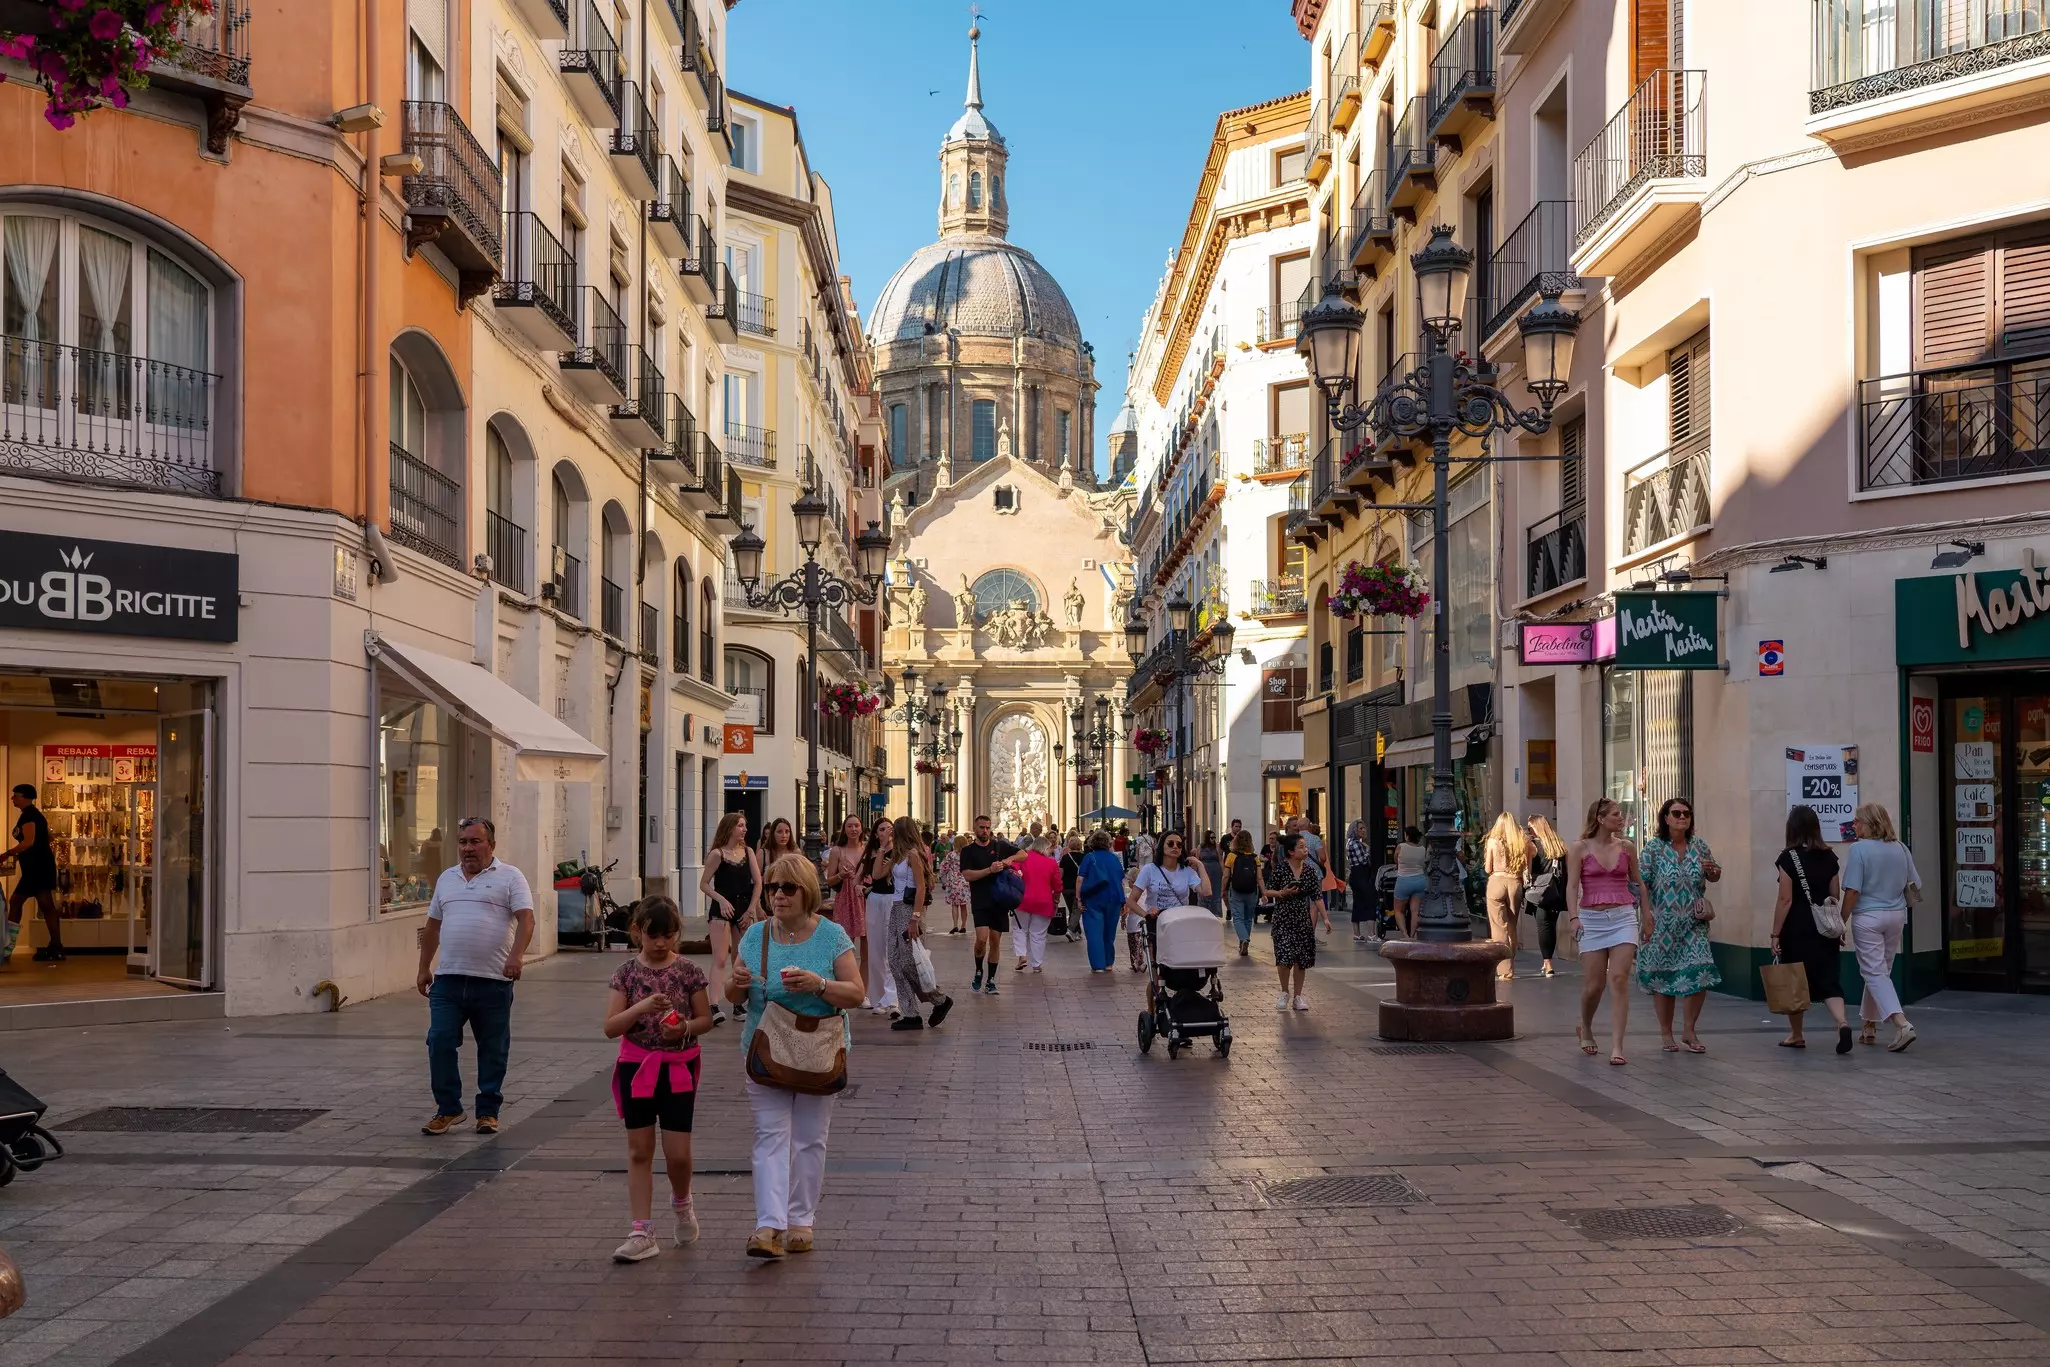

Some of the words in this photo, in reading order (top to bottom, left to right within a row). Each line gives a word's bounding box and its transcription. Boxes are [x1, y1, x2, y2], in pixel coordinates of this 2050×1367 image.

[1620, 600, 1684, 646] Martín
[1664, 625, 1714, 662] Martín
[1268, 676, 1287, 687] Shop
[1914, 735, 1931, 747] FRIGO
[1965, 744, 1983, 757] Pan
[50, 766, 60, 775] 1€
[118, 766, 130, 775] 3€
[1804, 778, 1841, 796] -20%
[1964, 787, 1986, 801] Café
[1791, 804, 1853, 814] CUENTO
[1958, 831, 1993, 845] Prensa
[1958, 872, 1994, 885] Recargas
